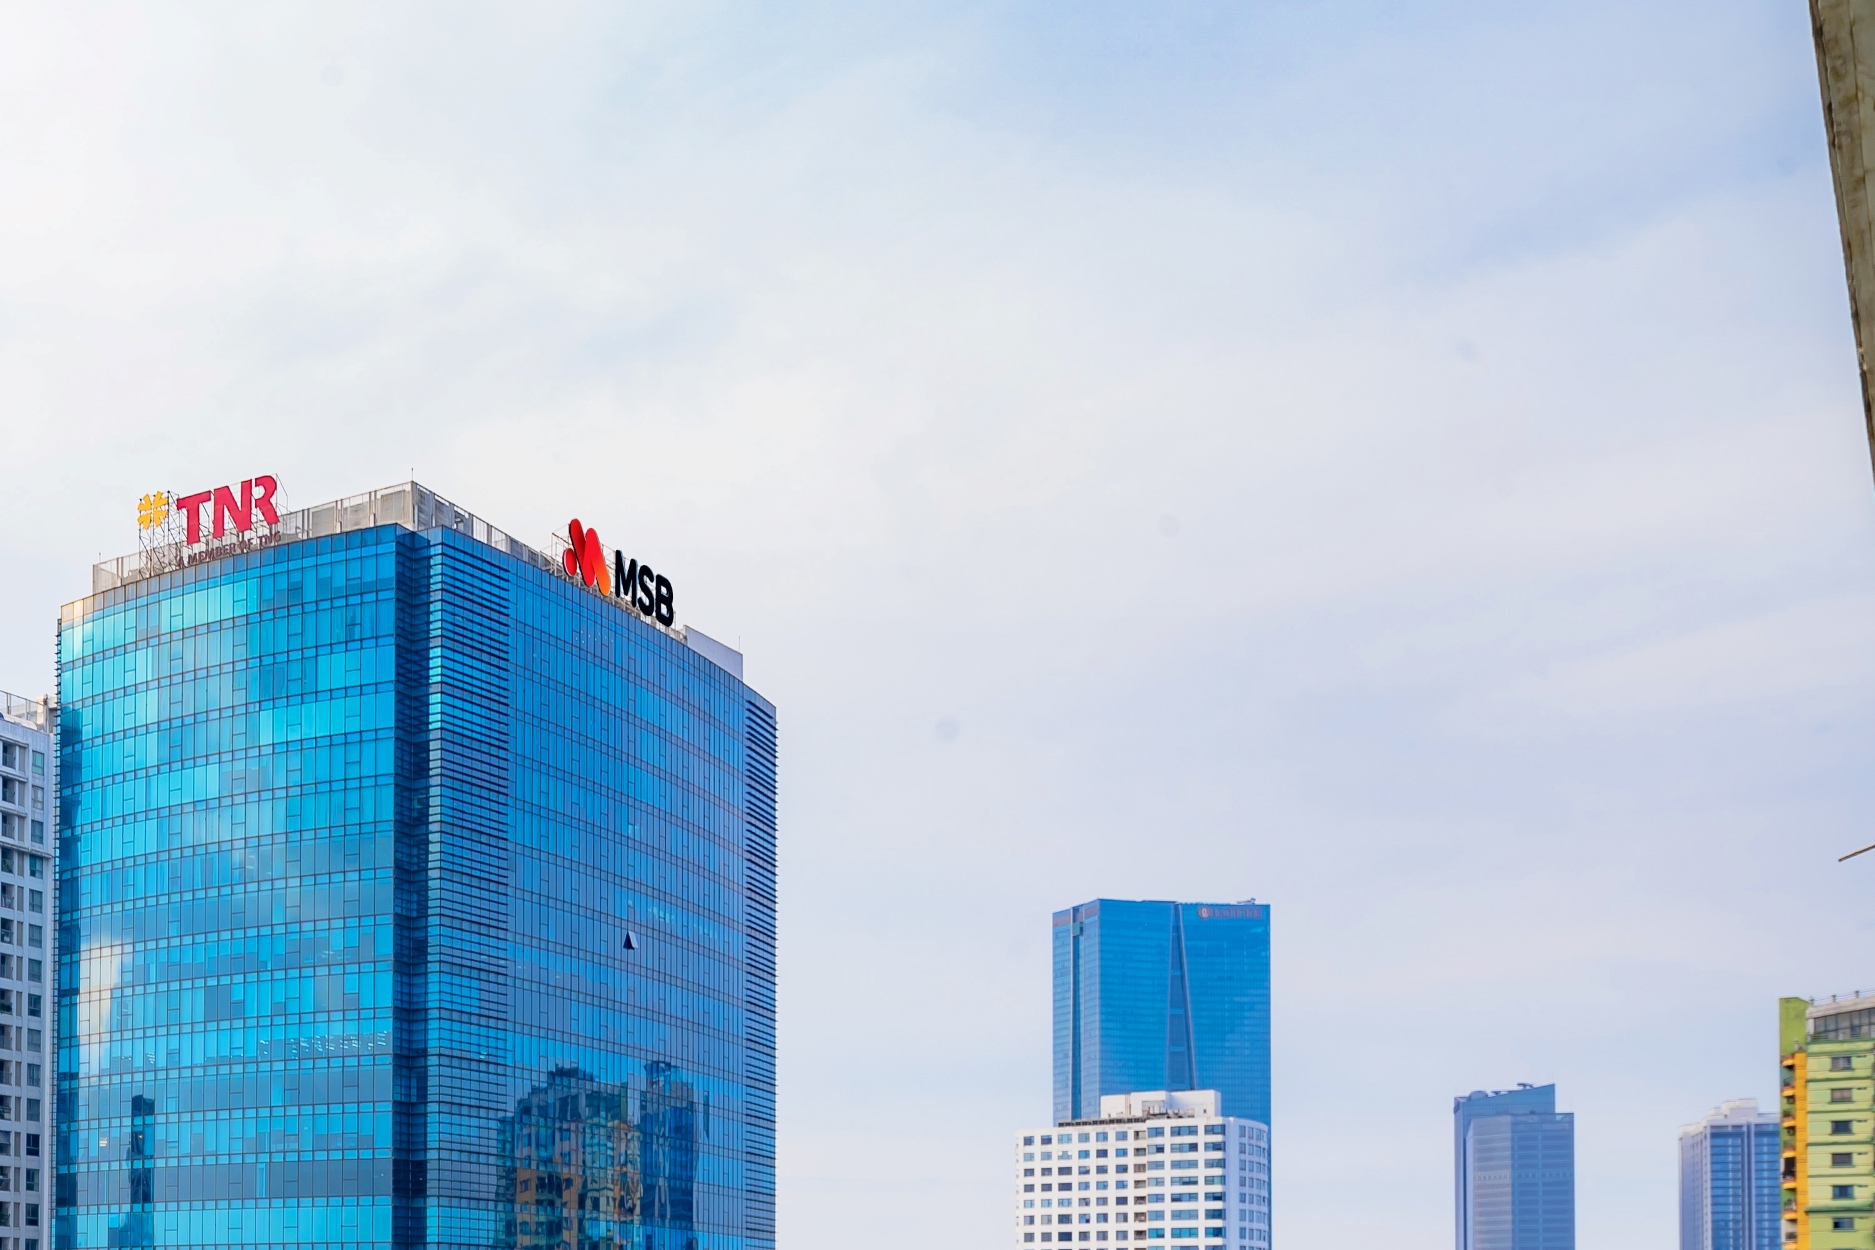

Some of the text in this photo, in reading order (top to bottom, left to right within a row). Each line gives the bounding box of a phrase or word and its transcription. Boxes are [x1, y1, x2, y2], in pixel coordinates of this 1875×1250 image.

[177, 475, 280, 546] TNR
[187, 541, 238, 567] MEMBER
[238, 535, 254, 552] OF
[257, 530, 281, 548] TNG
[615, 549, 674, 627] MSB
[1213, 908, 1262, 919] LOTTE
